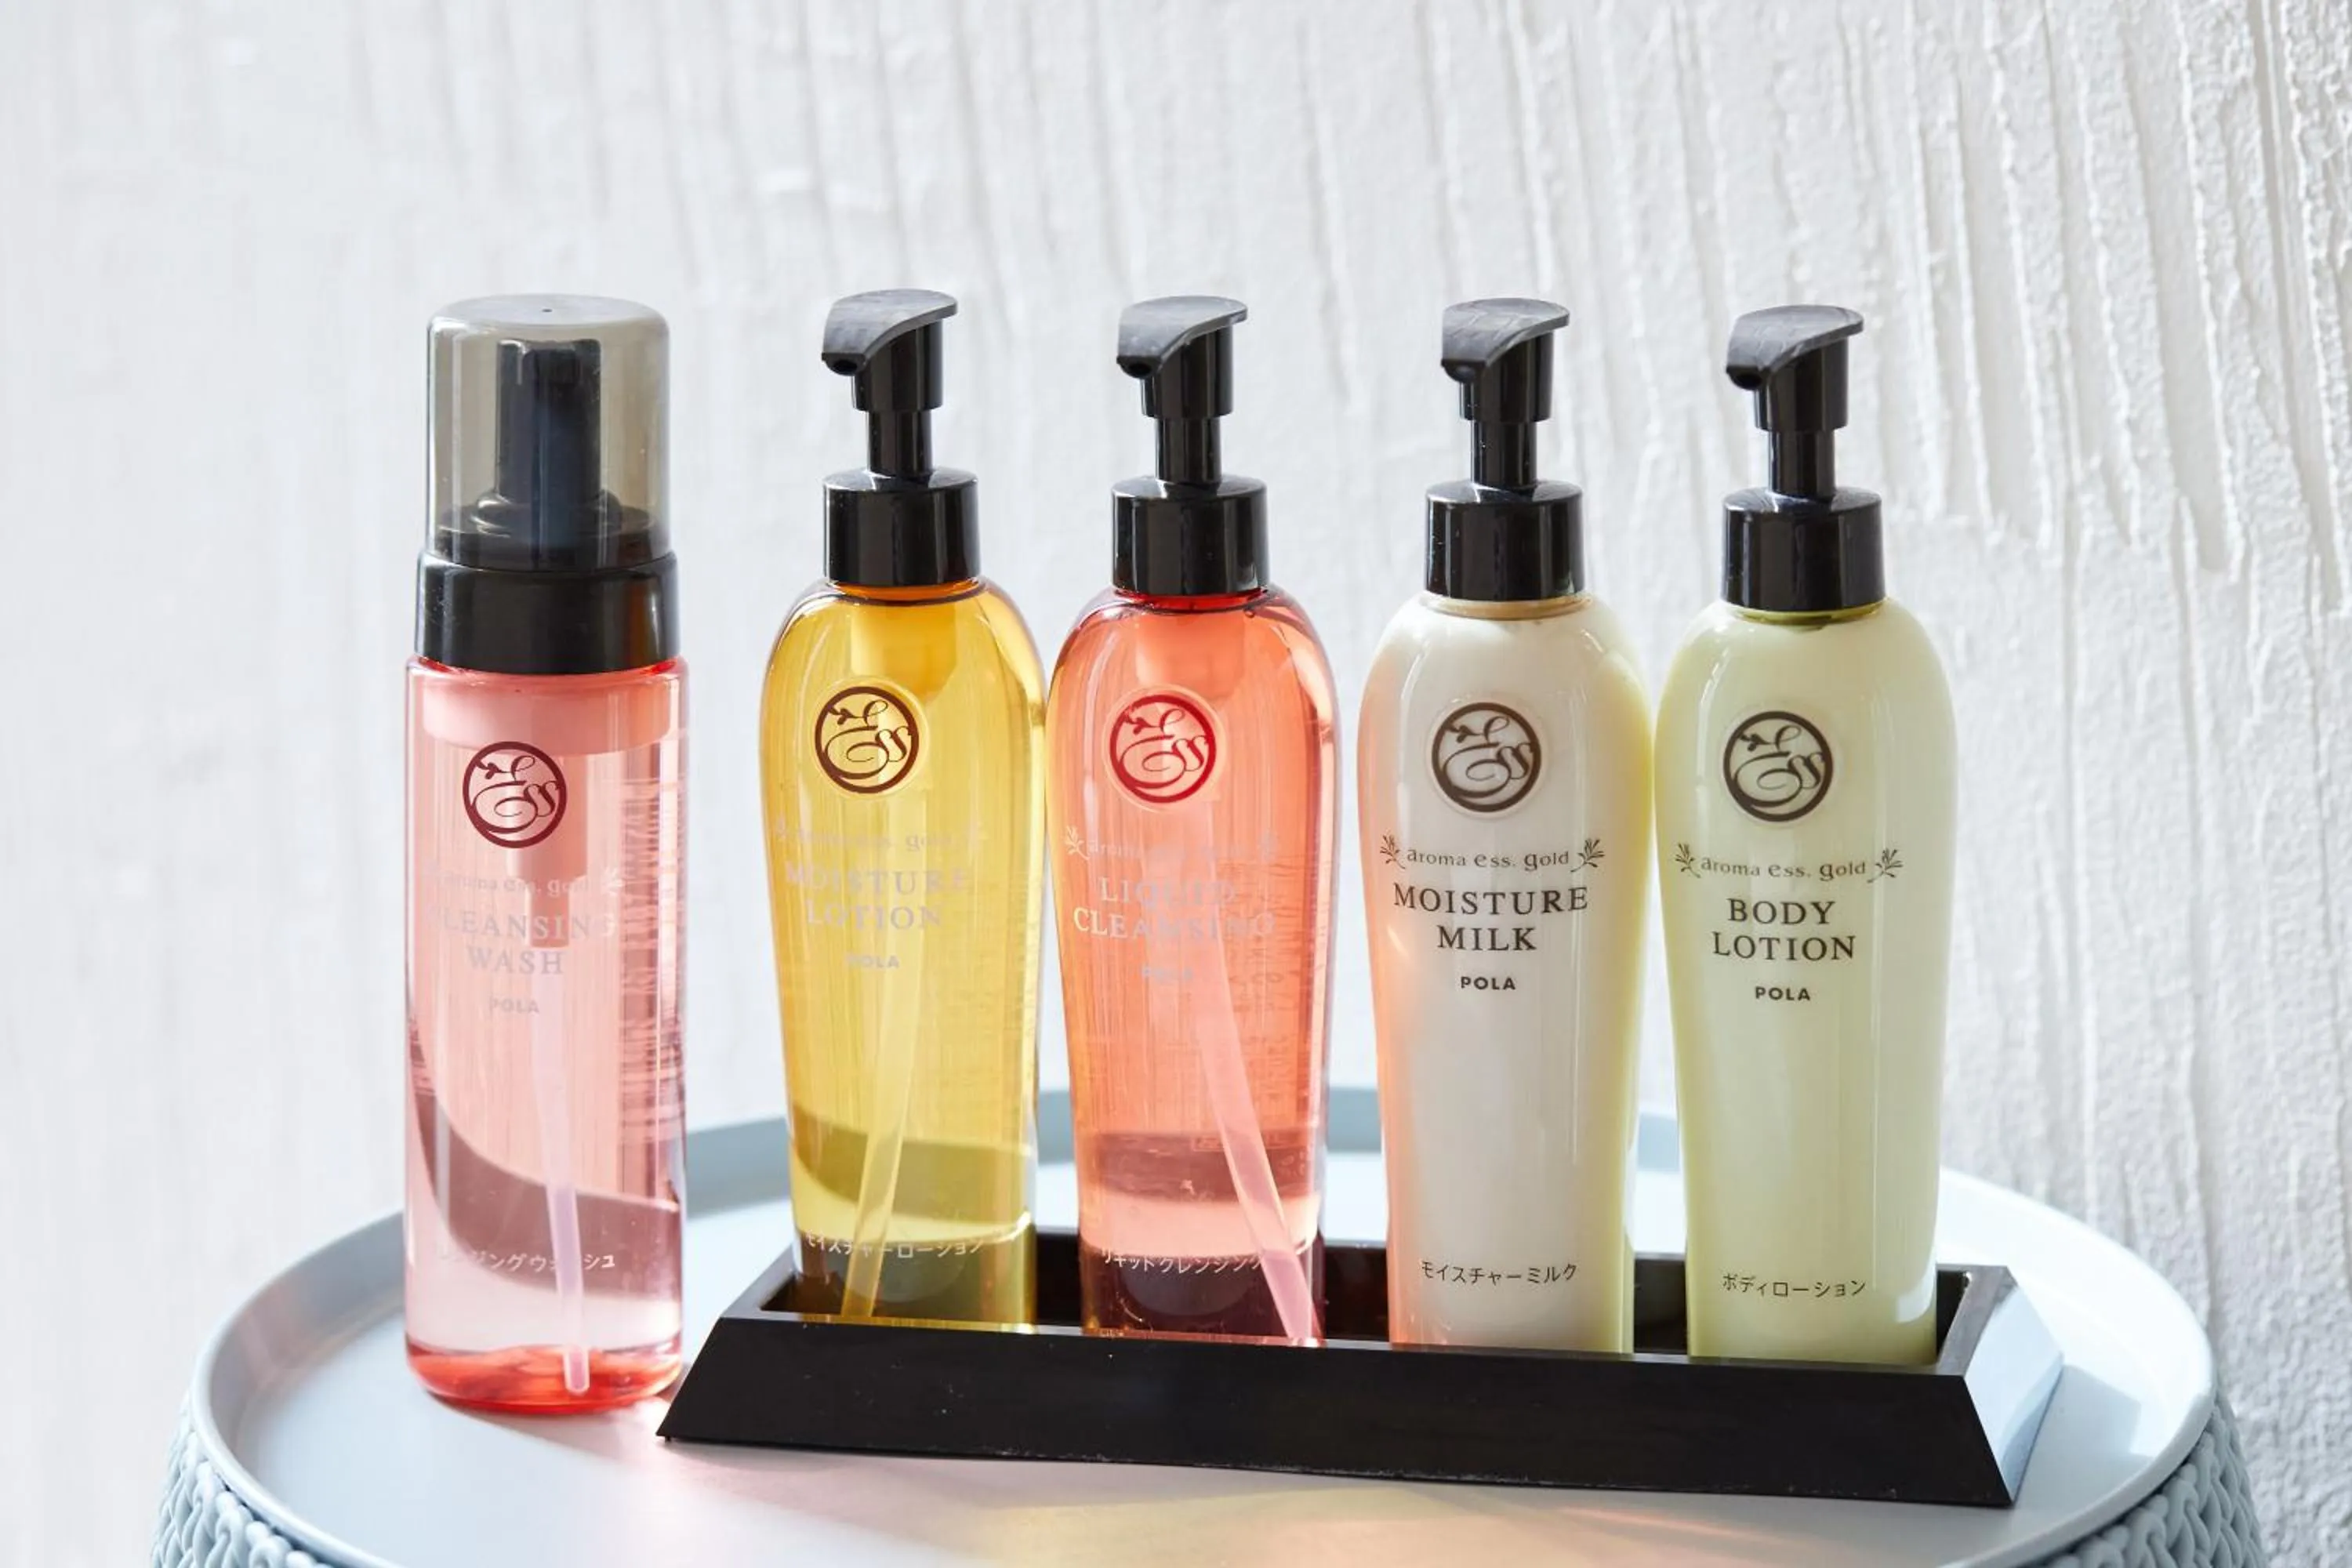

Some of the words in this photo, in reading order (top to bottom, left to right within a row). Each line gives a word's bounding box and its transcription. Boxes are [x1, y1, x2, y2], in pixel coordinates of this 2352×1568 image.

[1406, 848, 1466, 867] aroma
[1473, 852, 1516, 869] ess.
[1523, 851, 1570, 872] gold
[1700, 857, 1760, 877] aroma
[1767, 862, 1811, 878] ess.
[1819, 861, 1867, 882] gold
[784, 860, 967, 896] MOISTURE
[1393, 883, 1588, 916] MOISTURE
[1726, 898, 1836, 925] BODY
[429, 904, 617, 941] LEANSING
[806, 898, 942, 931] LOTION
[1437, 924, 1537, 952] MILK
[1711, 931, 1857, 961] LOTION
[466, 945, 565, 975] WASH
[847, 953, 901, 969] OLA
[1460, 976, 1517, 991] POLA
[1755, 986, 1811, 1001] POLA
[489, 996, 541, 1014] POLA
[1421, 1261, 1577, 1287] モイスチャーミルク
[1722, 1272, 1867, 1298] ボディローション
